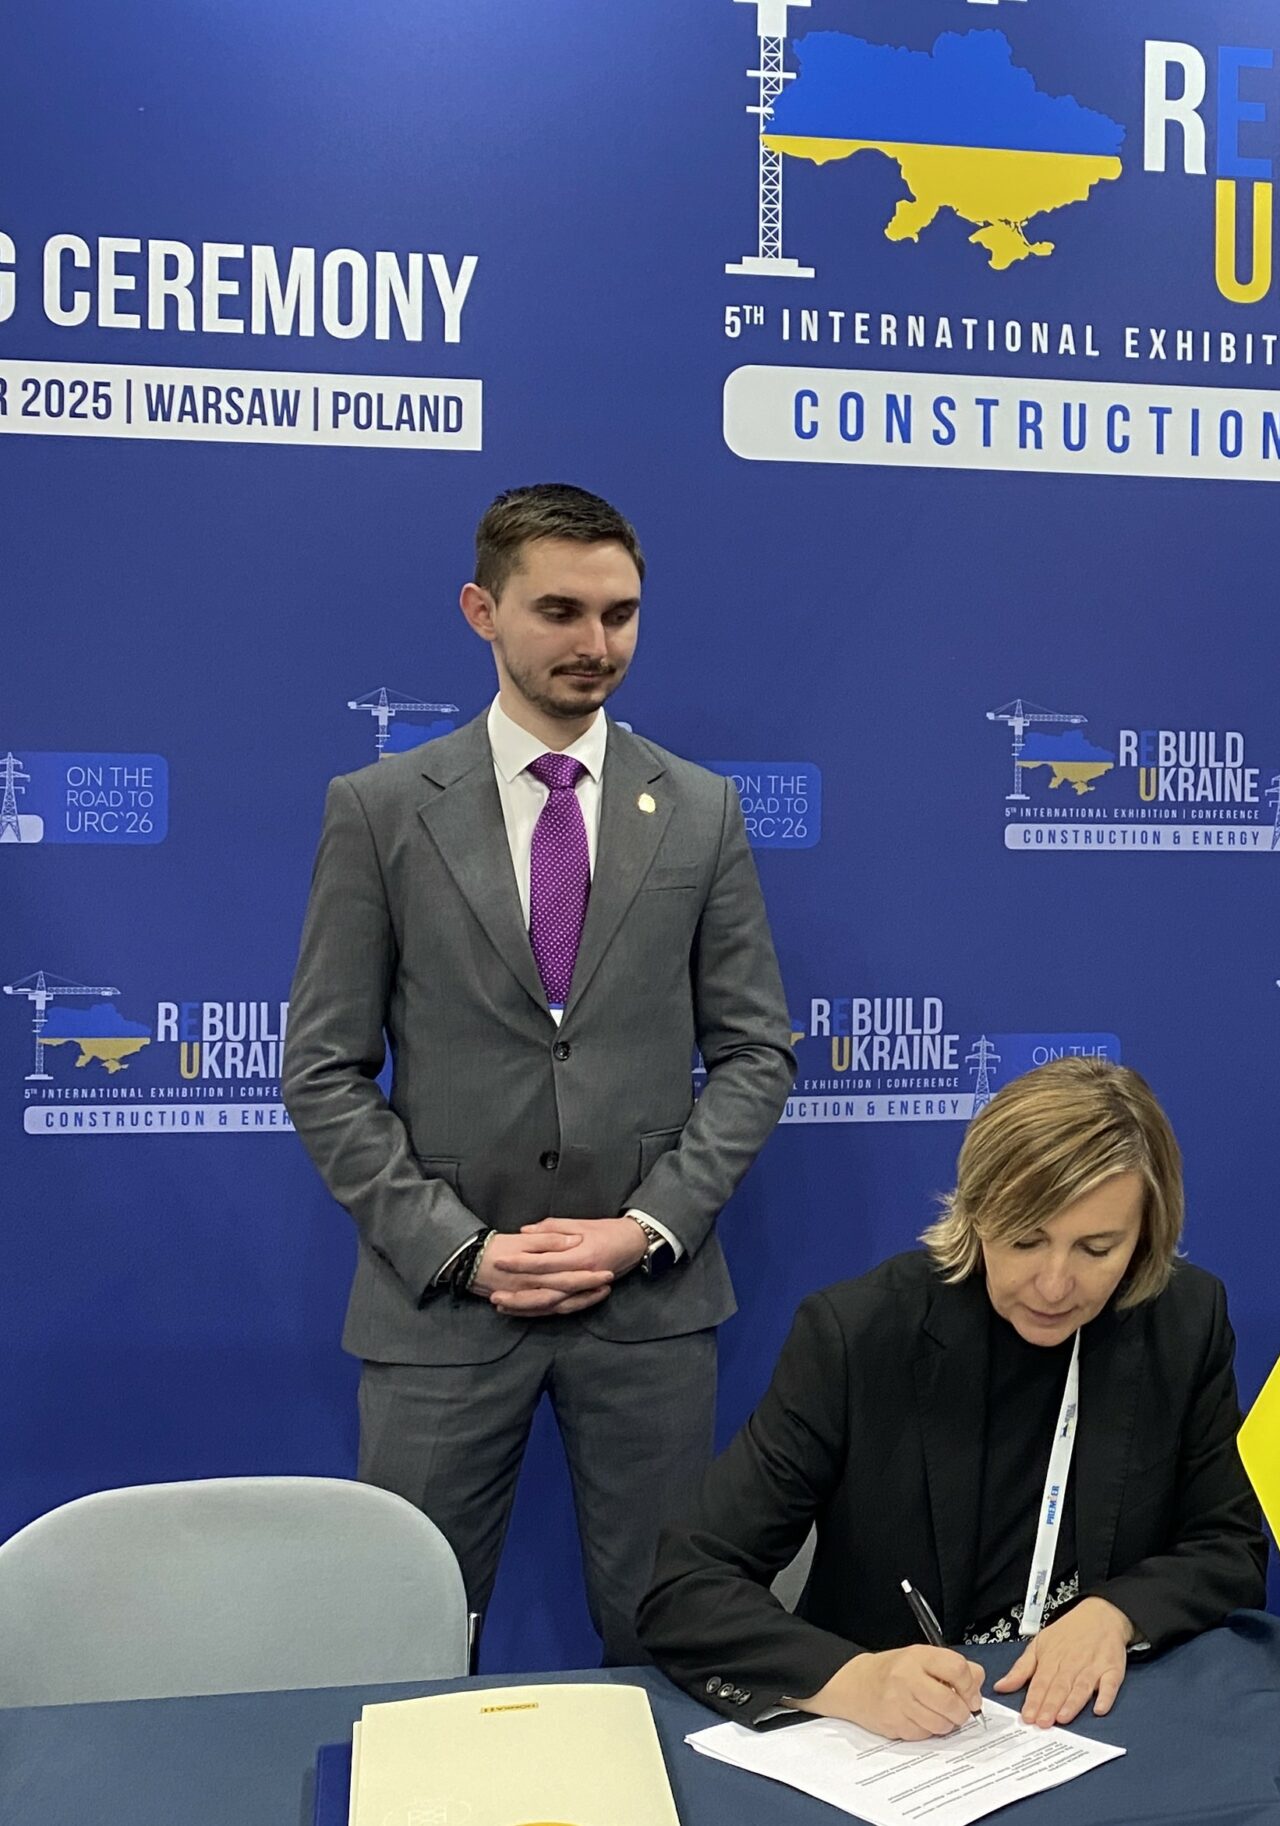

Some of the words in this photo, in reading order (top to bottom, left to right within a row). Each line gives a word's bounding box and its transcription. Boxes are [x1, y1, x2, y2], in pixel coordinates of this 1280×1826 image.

[44, 234, 478, 343] CEREMONY
[725, 305, 764, 338] 5TH
[783, 309, 1099, 356] INTERNATIONAL
[21, 378, 112, 420] 2025
[144, 383, 301, 427] WARSAW
[332, 391, 463, 433] POLAND
[1119, 730, 1244, 768] REBUILD
[67, 766, 102, 786] ON
[109, 767, 152, 787] THE
[767, 775, 807, 795] THE
[1139, 767, 1259, 802] UKRAINE
[67, 790, 123, 807] ROAD
[128, 790, 154, 808] TO
[738, 795, 780, 816] OAD
[784, 797, 808, 814] TO
[1020, 808, 1107, 818] INTERNATIONAL
[1114, 808, 1177, 818] EXHIBITION
[1191, 809, 1259, 819] CONFERENCE
[1023, 829, 1161, 845] CONSTRUCTION
[1173, 831, 1180, 845] &
[1193, 831, 1259, 845] ENERGY
[157, 1002, 290, 1042] REBUIL
[811, 997, 943, 1036] REBUILD
[180, 1041, 285, 1079] UKRAI
[832, 1034, 959, 1072] UKRAINE
[42, 1088, 143, 1098] INTERNATIONAL
[151, 1087, 223, 1098] EXHIBITION
[240, 1086, 283, 1097] CONFE
[804, 1079, 871, 1090] EXHIBITION
[887, 1077, 958, 1088] CONFERENCE
[45, 1110, 204, 1128] CONSTRUCTION
[219, 1110, 227, 1125] &
[241, 1108, 293, 1125] ENER
[786, 1102, 854, 1118] UCTION
[867, 1101, 875, 1116] &
[888, 1100, 959, 1115] ENERGY
